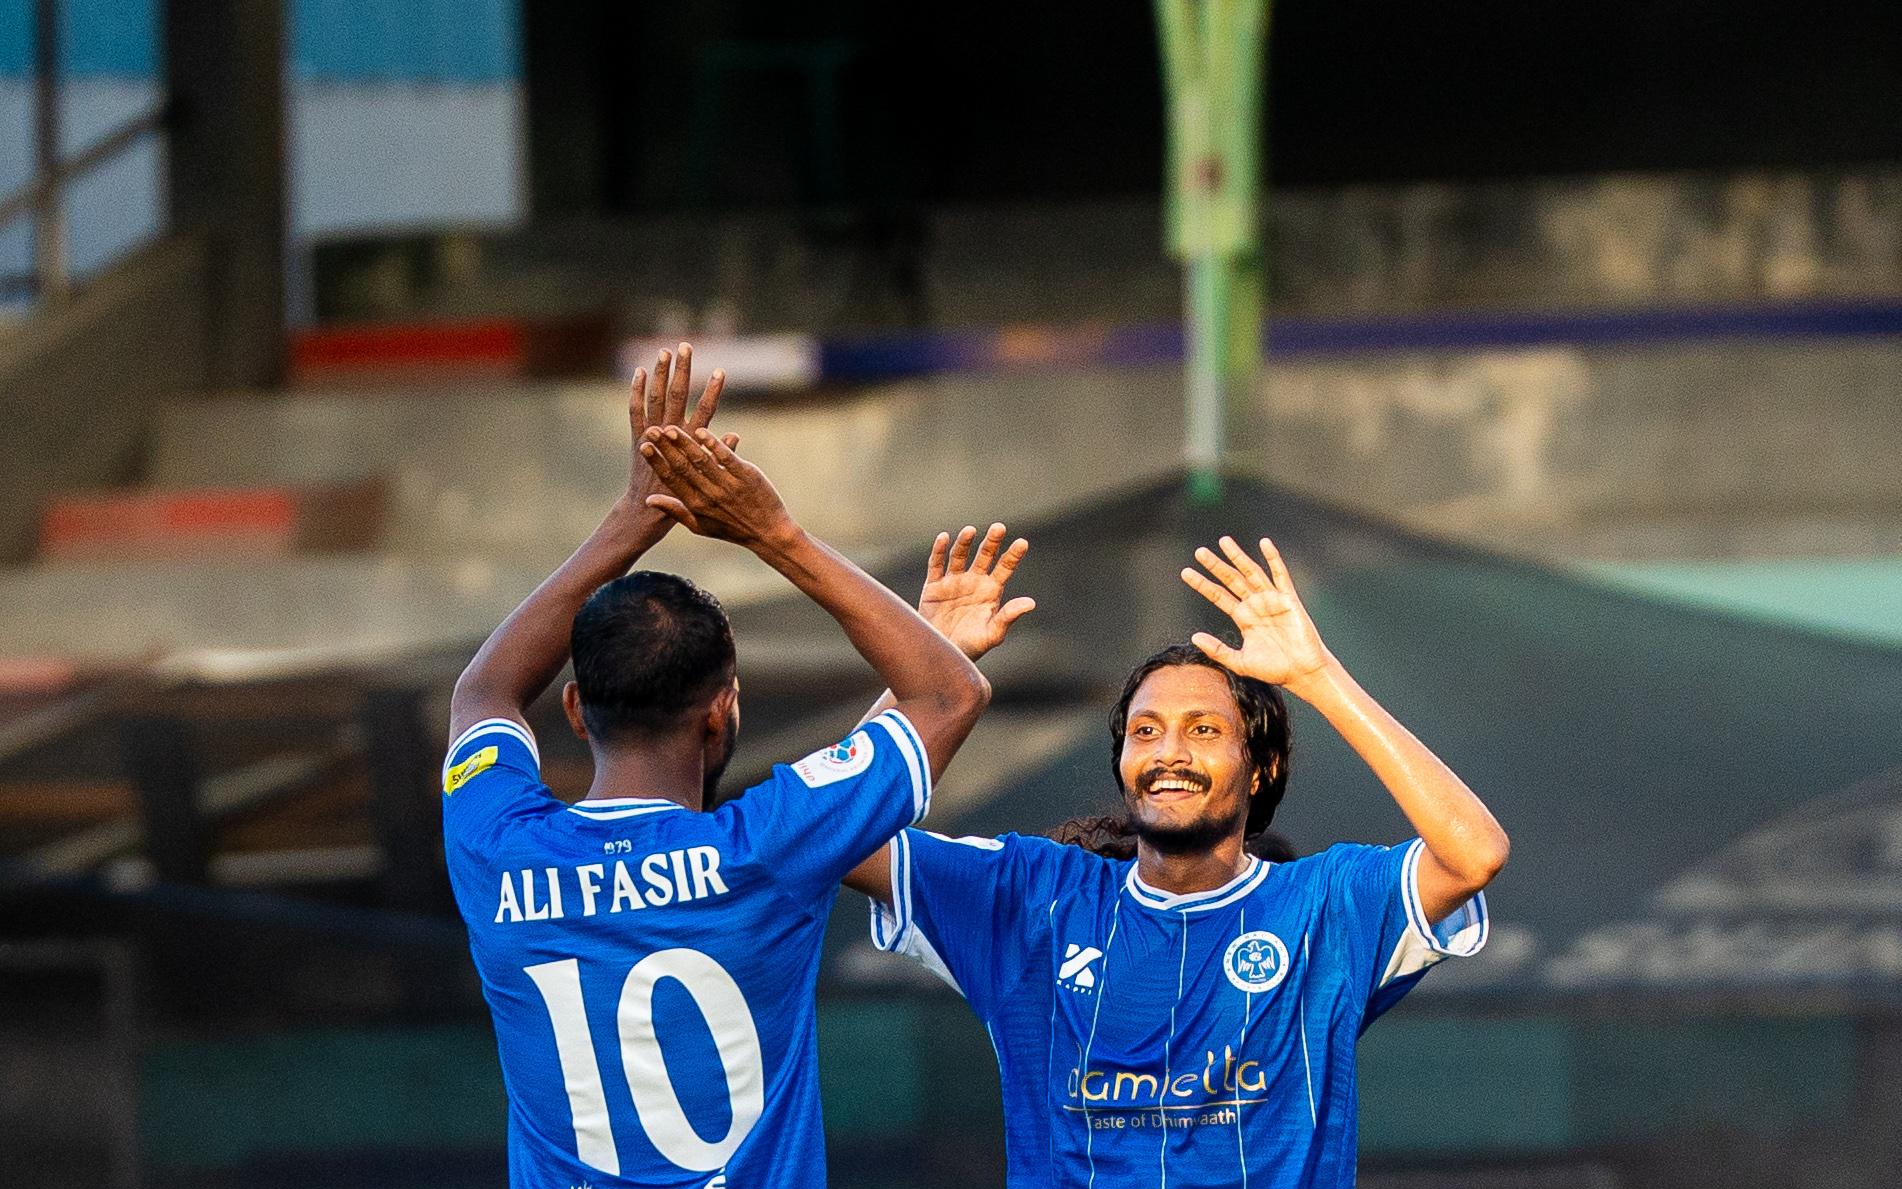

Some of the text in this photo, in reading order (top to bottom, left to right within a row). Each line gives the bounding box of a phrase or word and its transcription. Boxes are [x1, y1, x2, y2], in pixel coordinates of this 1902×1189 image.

[603, 839, 632, 855] 1979
[494, 845, 730, 924] ALI FASIR
[522, 947, 765, 1177] 10
[1130, 1113, 1146, 1129] of
